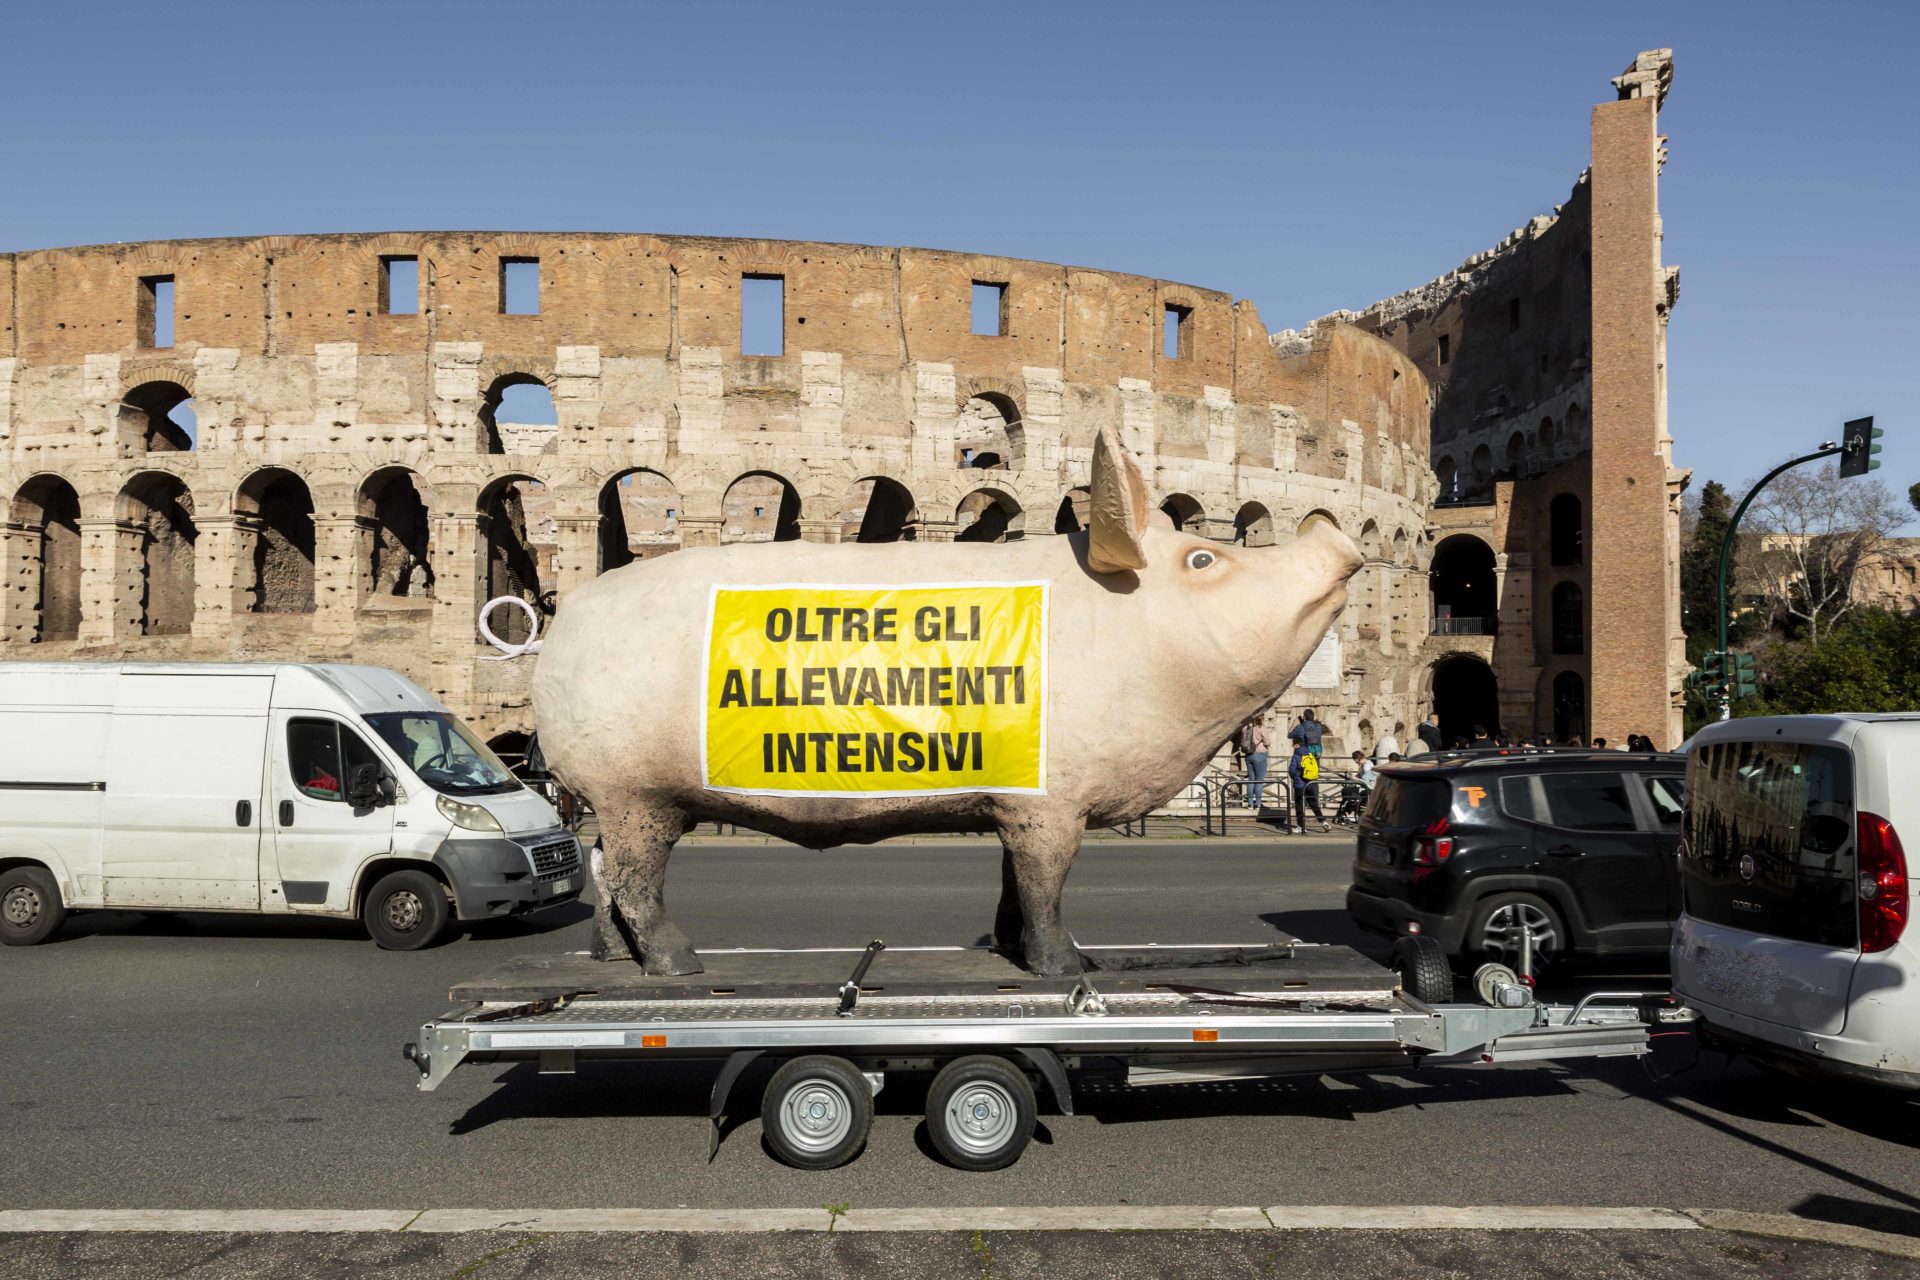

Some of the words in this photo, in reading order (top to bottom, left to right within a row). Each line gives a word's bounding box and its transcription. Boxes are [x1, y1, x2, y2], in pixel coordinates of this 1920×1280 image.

[765, 607, 897, 642] OLTRE
[914, 606, 981, 642] GLI
[719, 665, 1026, 708] ALLEVAMENTI
[763, 731, 983, 773] INTENSIVI
